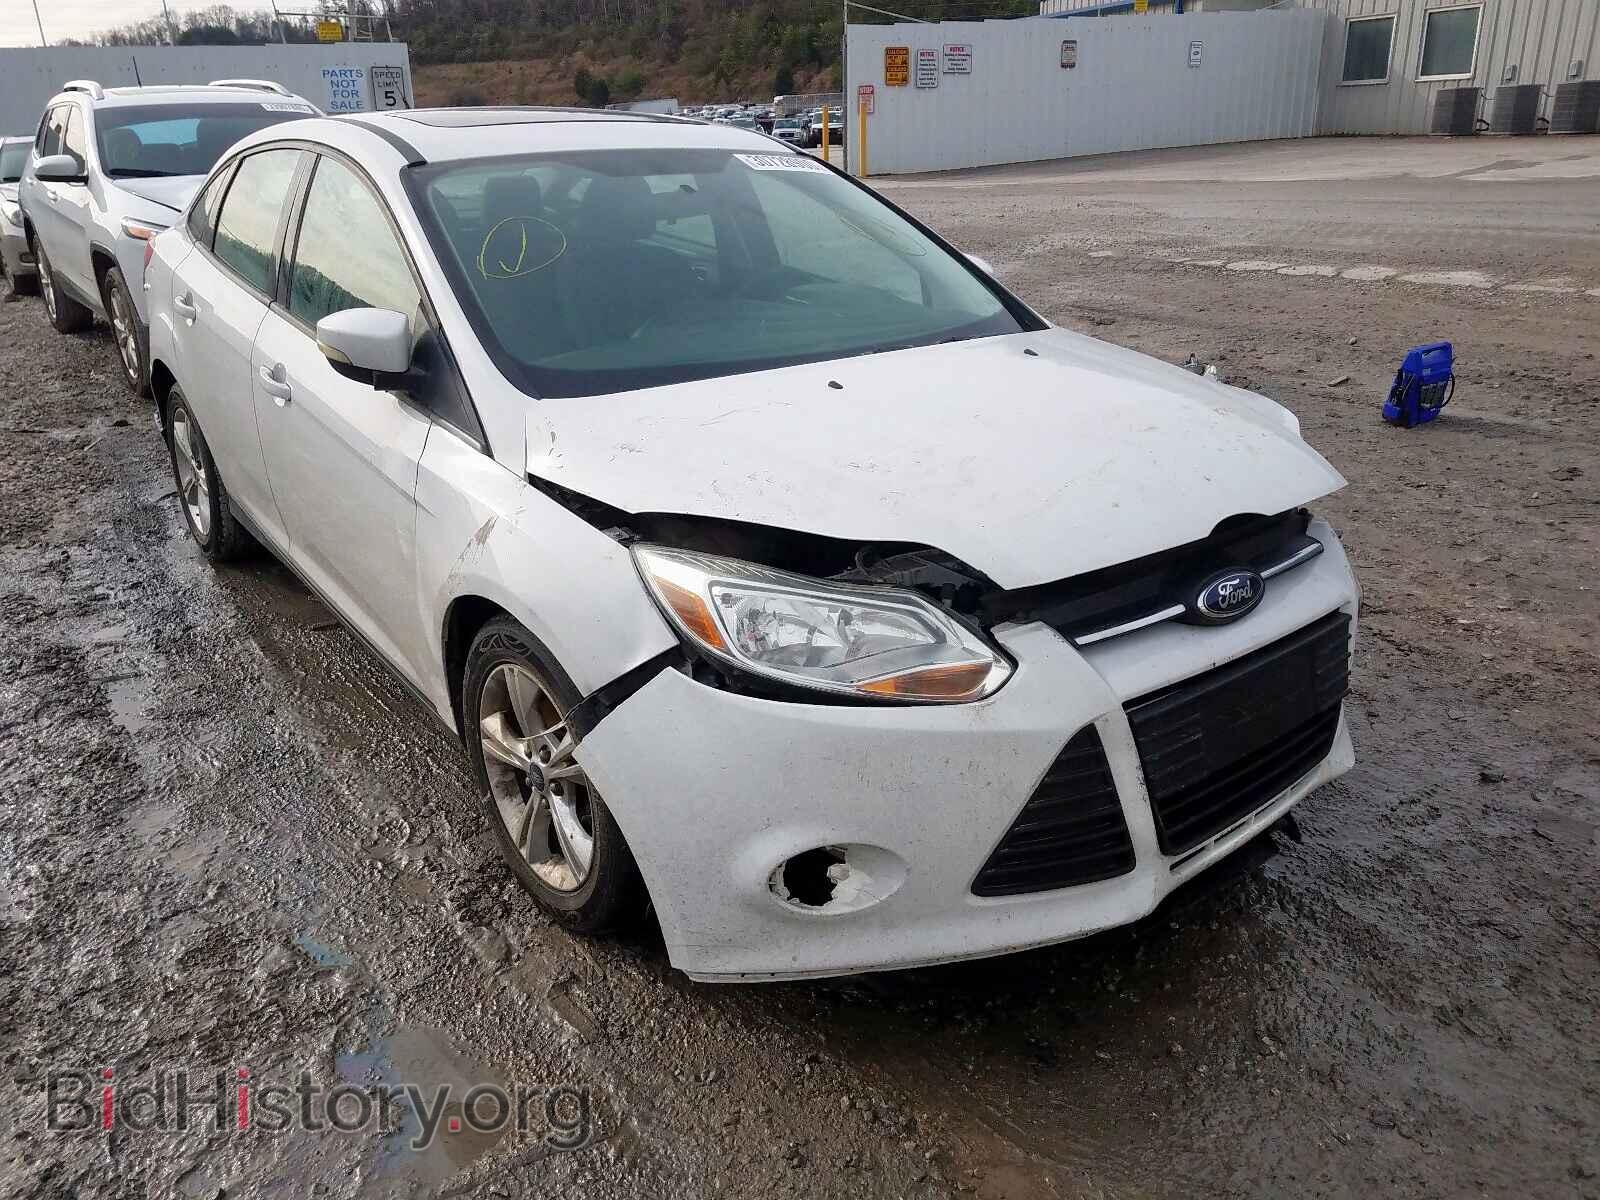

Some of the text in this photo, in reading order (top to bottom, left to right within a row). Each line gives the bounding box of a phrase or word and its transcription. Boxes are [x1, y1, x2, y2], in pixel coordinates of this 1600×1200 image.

[322, 69, 364, 78] PARTS
[331, 79, 358, 88] NOT
[333, 90, 360, 98] FOR
[384, 90, 397, 106] 5
[331, 101, 364, 110] SALE
[1218, 578, 1253, 608] Ford
